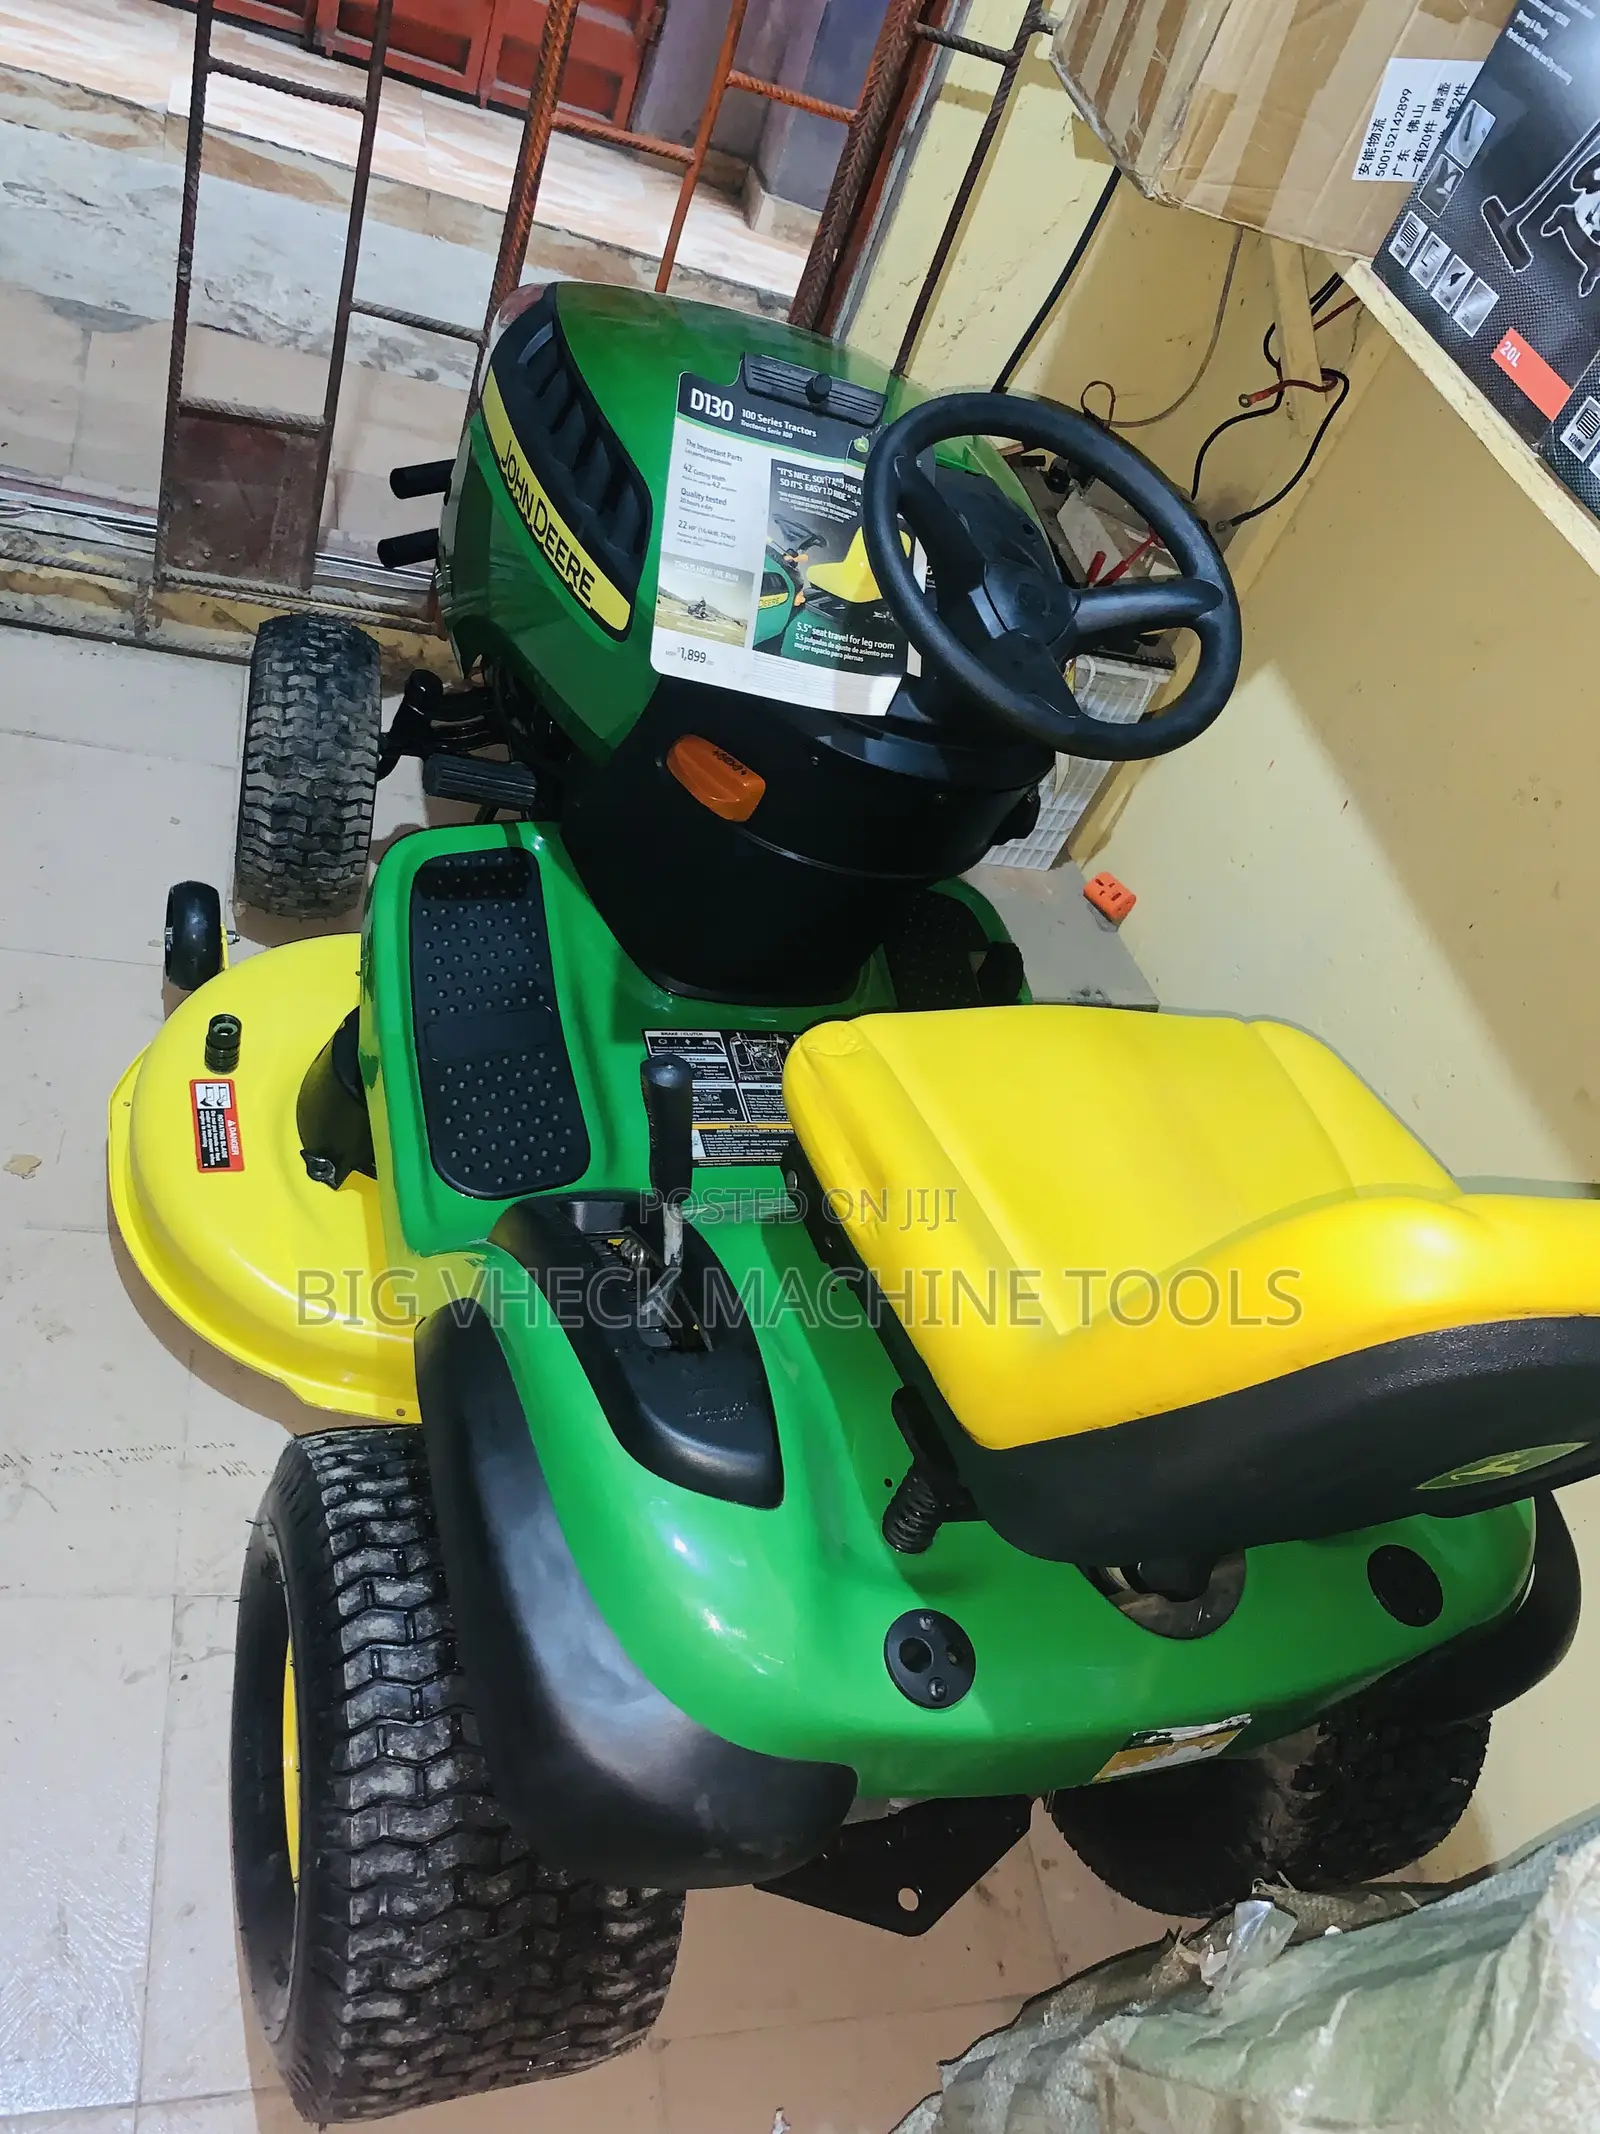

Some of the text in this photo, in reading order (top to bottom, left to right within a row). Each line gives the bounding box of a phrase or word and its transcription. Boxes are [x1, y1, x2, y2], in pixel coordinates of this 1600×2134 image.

[1375, 88, 1413, 177] 500152142899
[1392, 105, 1427, 177] 广东 佛山
[1358, 118, 1387, 175] 安能物流
[1412, 119, 1438, 178] 一箱20件
[1500, 341, 1521, 368] 20L
[690, 388, 734, 421] D130
[741, 408, 817, 438] 100 Series Tractors
[767, 427, 782, 437] Serie
[782, 430, 794, 439] 100
[686, 438, 743, 462] The Important Parts
[681, 487, 705, 502] Quality
[706, 494, 727, 506] tested
[779, 478, 789, 488] SO
[790, 480, 803, 490] IT'S
[805, 484, 821, 494] EASY
[501, 440, 595, 603] JOHN DEERE
[678, 519, 688, 529] 22
[812, 627, 828, 637] seat
[828, 631, 849, 642] travel
[849, 636, 861, 645] for
[861, 637, 873, 649] leg
[874, 641, 895, 650] room
[794, 642, 811, 651] mayor
[811, 646, 831, 654] espacio
[843, 653, 864, 662] piernas
[859, 649, 880, 657] asiento
[217, 1114, 226, 1140] ROTATING
[230, 1128, 239, 1156] DANGER
